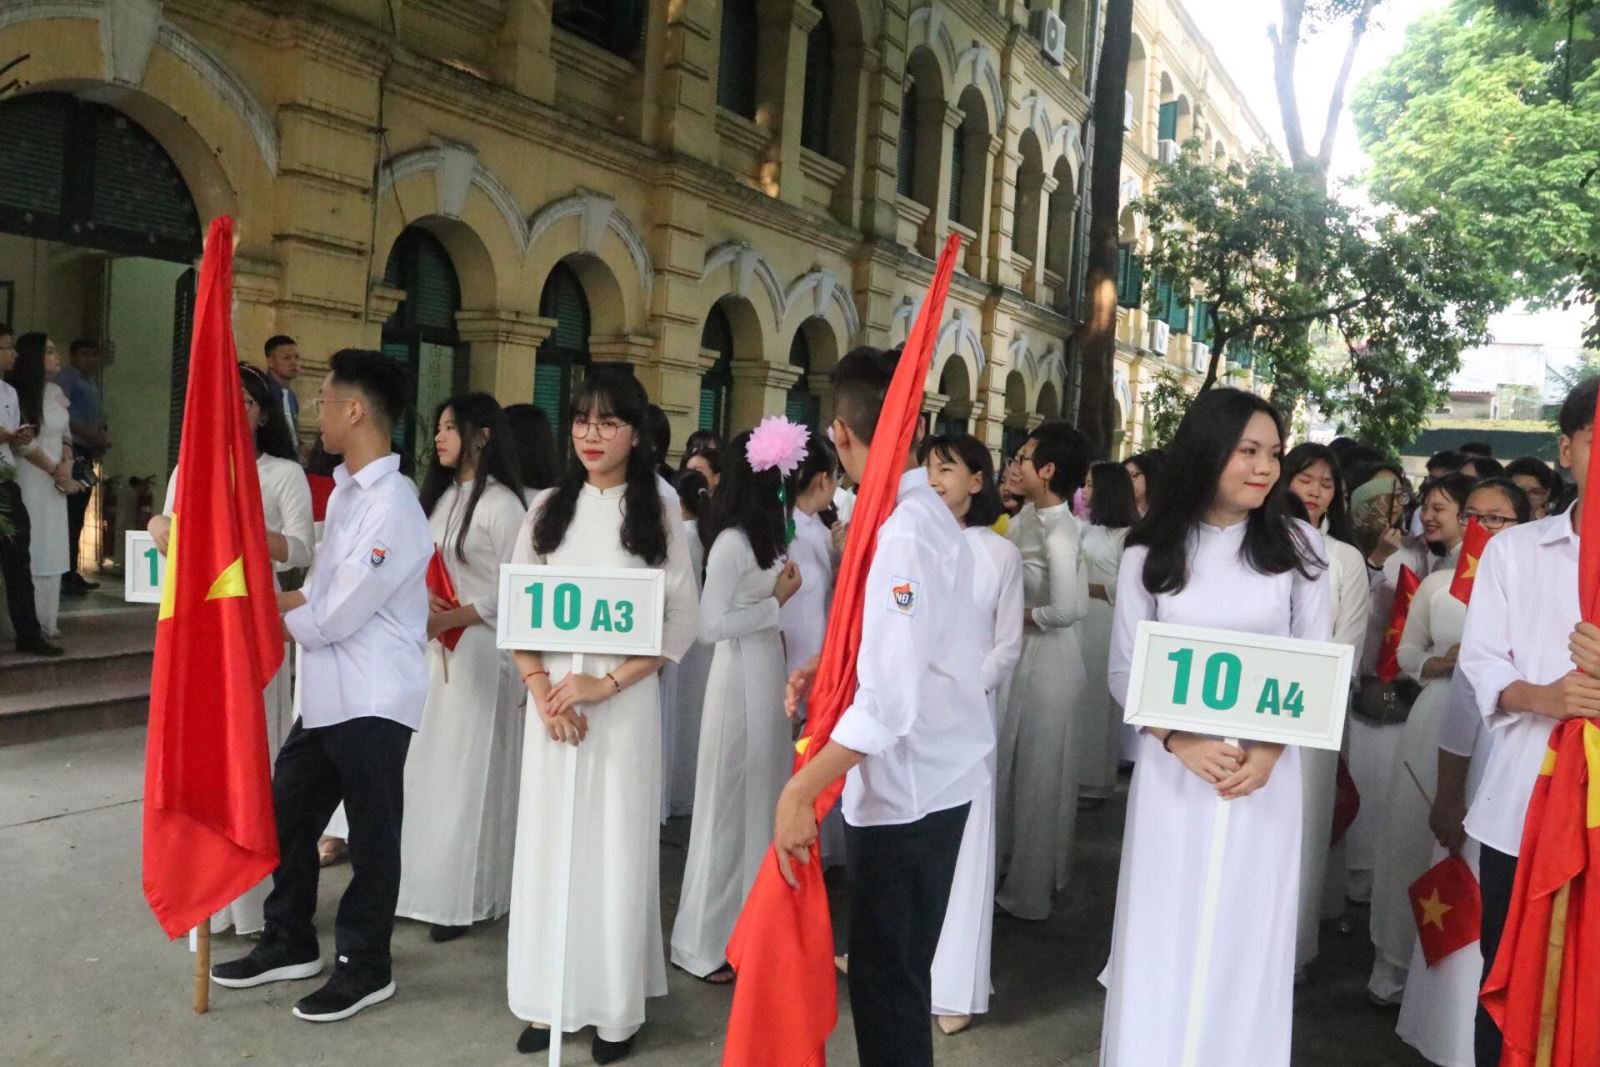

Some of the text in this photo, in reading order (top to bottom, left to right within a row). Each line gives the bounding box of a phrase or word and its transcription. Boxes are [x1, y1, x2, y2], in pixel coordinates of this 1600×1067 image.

[524, 582, 634, 634] 10 A3
[1167, 648, 1305, 718] 10 A4
